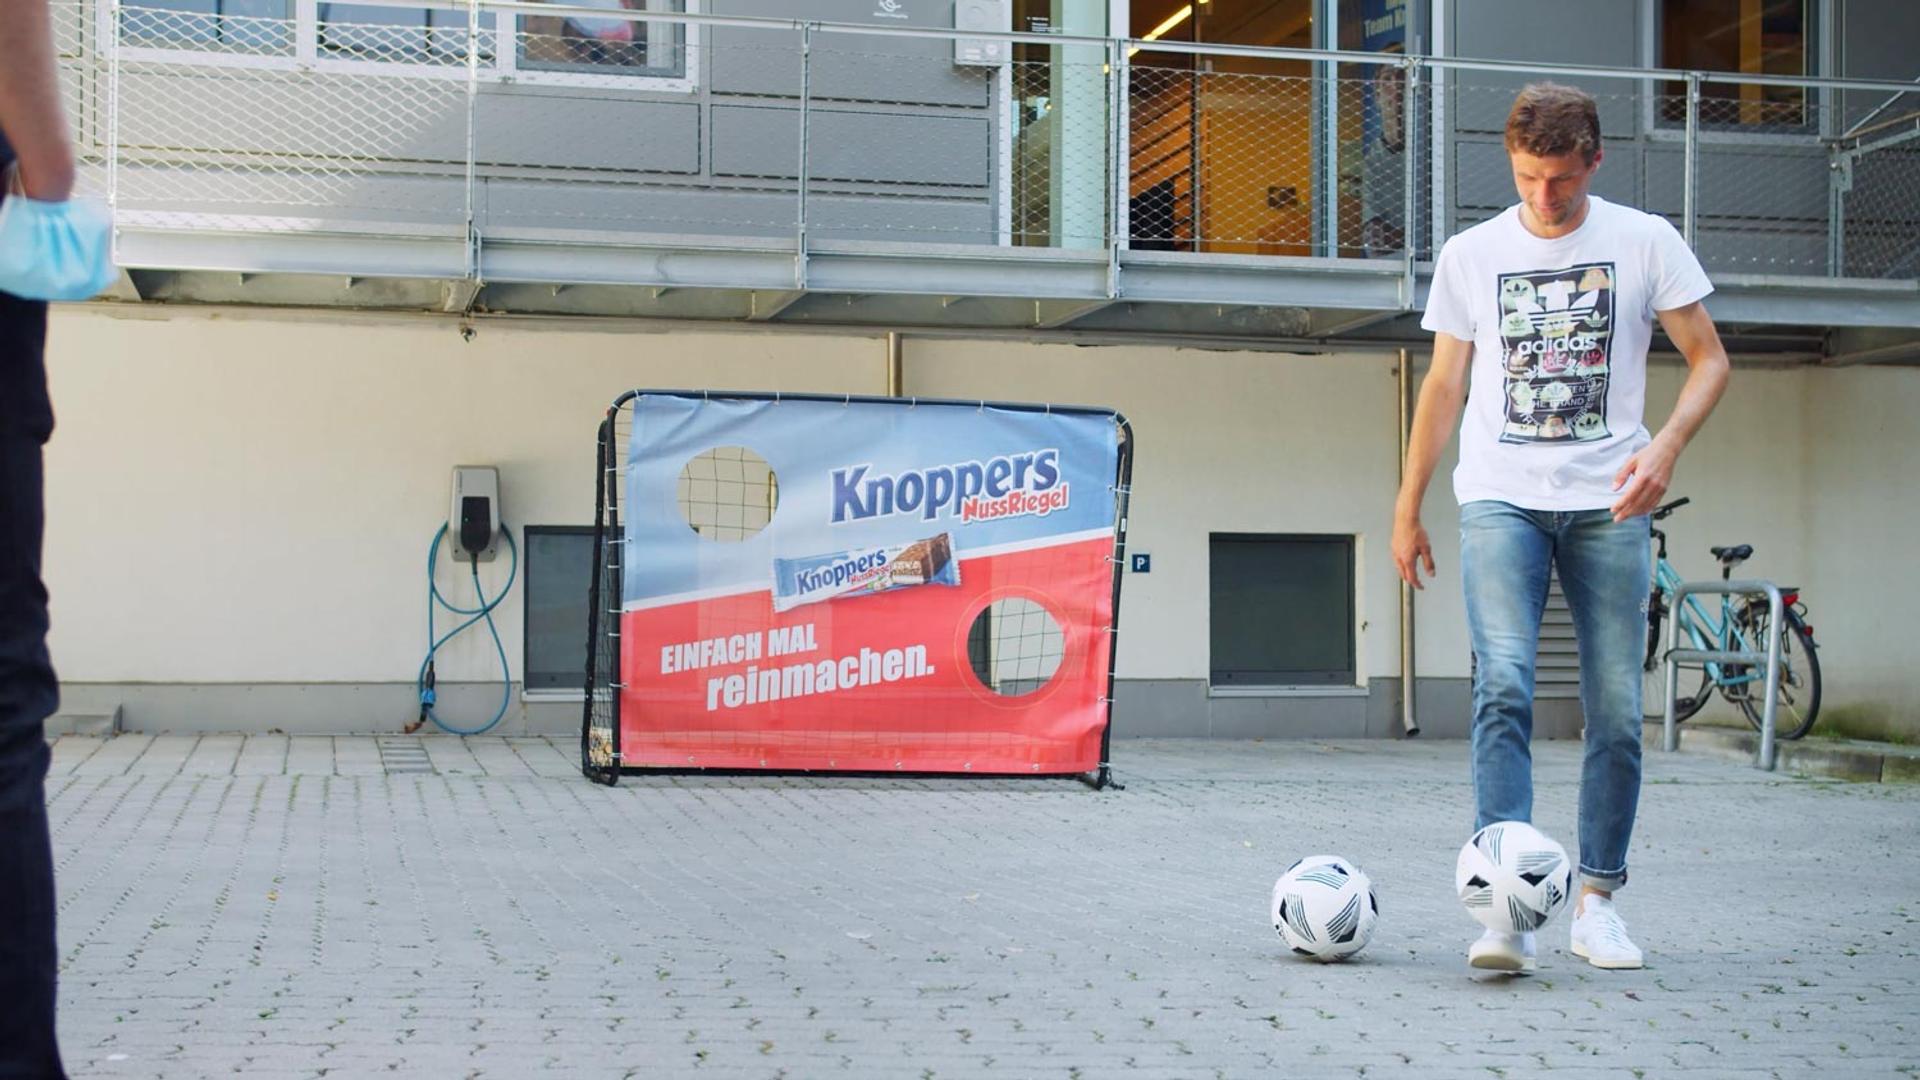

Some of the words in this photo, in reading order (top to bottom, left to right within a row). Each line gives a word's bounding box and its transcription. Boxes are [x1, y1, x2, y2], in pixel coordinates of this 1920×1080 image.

[1517, 332, 1597, 356] adidas
[831, 450, 1059, 523] Knoppers
[962, 485, 1068, 522] NussRiegel
[797, 549, 887, 596] Knoppers
[1136, 556, 1145, 570] P
[660, 632, 762, 674] EINFACH
[768, 623, 818, 657] MAL
[706, 644, 935, 711] reinmachen.
